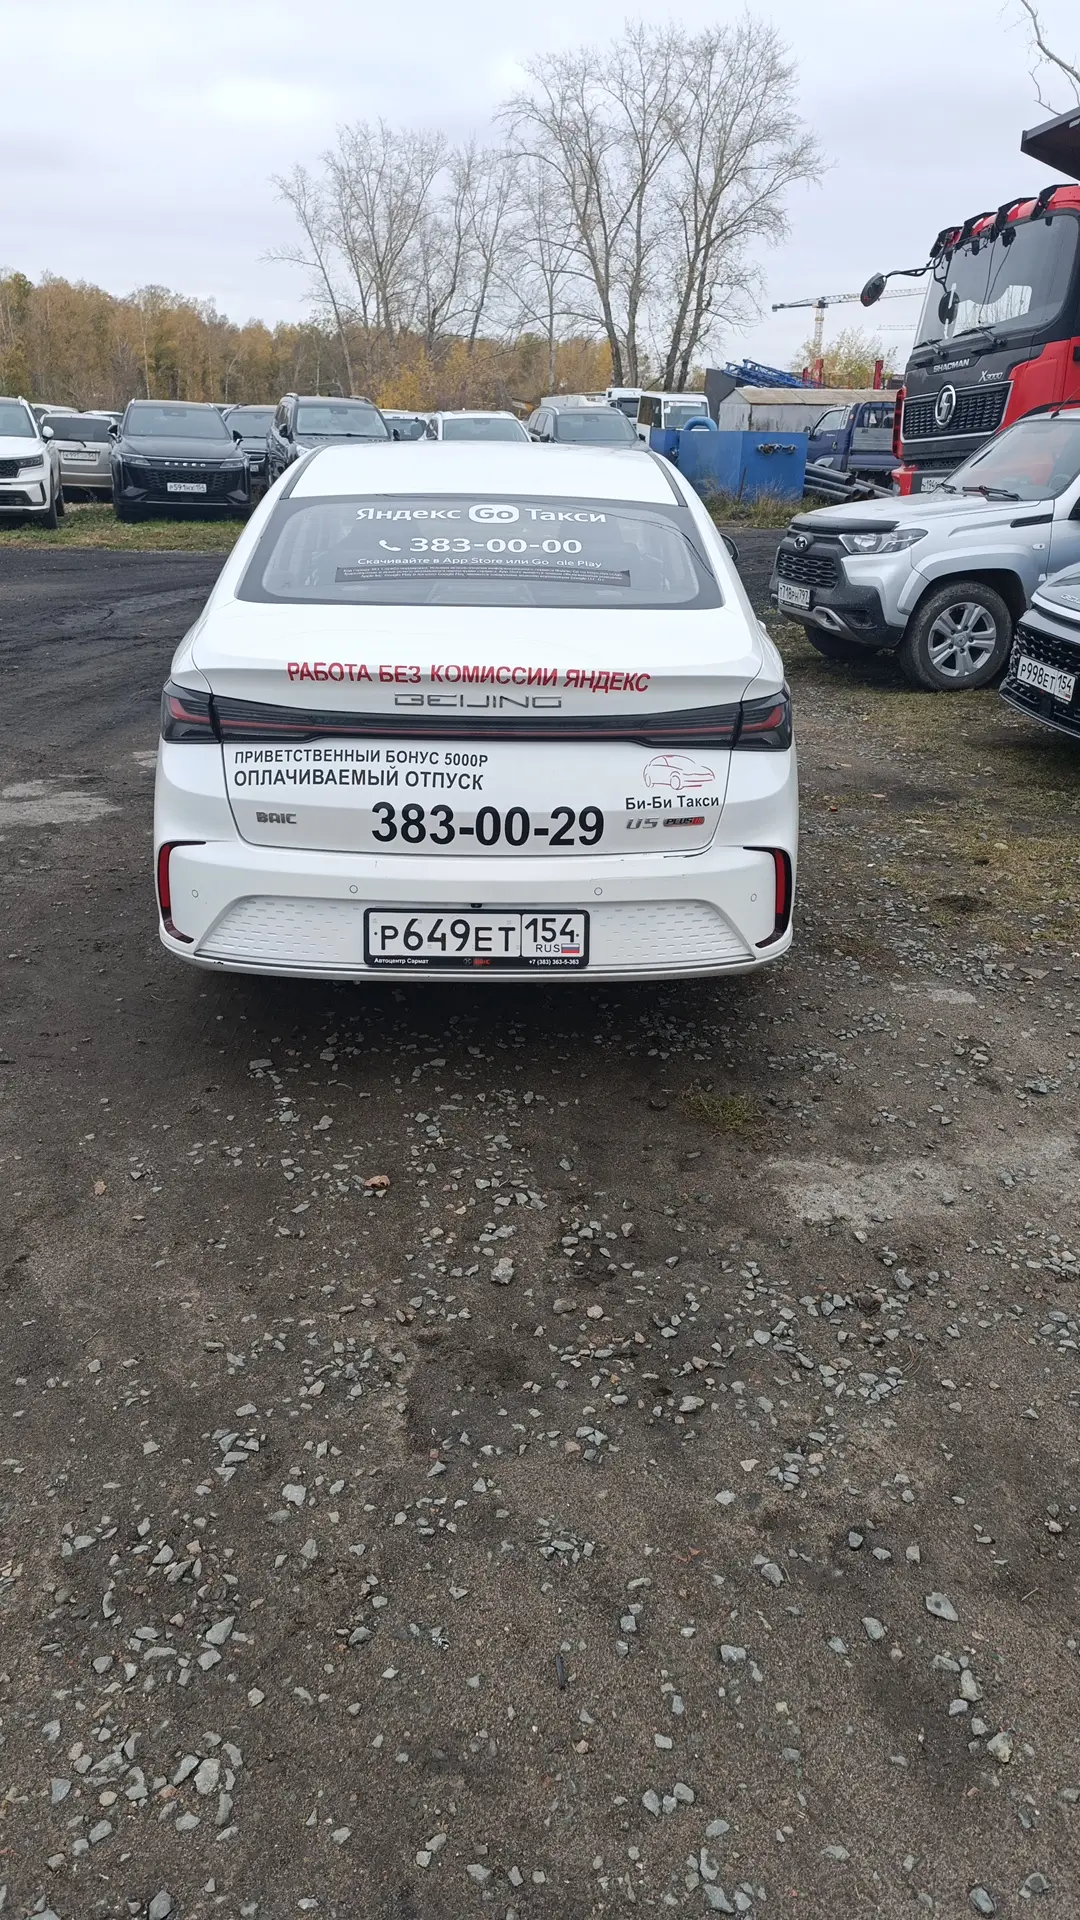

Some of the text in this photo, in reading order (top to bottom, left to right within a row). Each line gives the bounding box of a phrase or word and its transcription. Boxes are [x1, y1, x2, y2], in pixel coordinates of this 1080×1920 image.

[933, 359, 970, 373] SHACMAN
[356, 507, 607, 523] Яндекс Go Такси
[409, 537, 583, 554] 383-00-00
[357, 556, 430, 565] Скачивайте
[442, 556, 468, 565] App
[577, 560, 602, 568] Play
[287, 662, 651, 693] РАБОТА БЕЗ КОМИССИИ ЯНДЕКС
[1020, 662, 1072, 693] Р998ЕТ 154
[394, 692, 562, 708] BEIJING
[386, 750, 439, 765] БОНУС
[444, 752, 488, 768] 5000Р
[234, 765, 484, 790] ОПЛАЧИВАЕМЫЙ ОТПУСК
[625, 795, 719, 810] Би-Би Такси
[256, 811, 297, 824] BAIC
[371, 801, 604, 846] 383-00-29
[665, 817, 694, 826] PLUS
[381, 917, 575, 951] Р649ЕТ 154
[535, 943, 561, 953] RUS
[374, 957, 429, 966] Автоцентр Сармат
